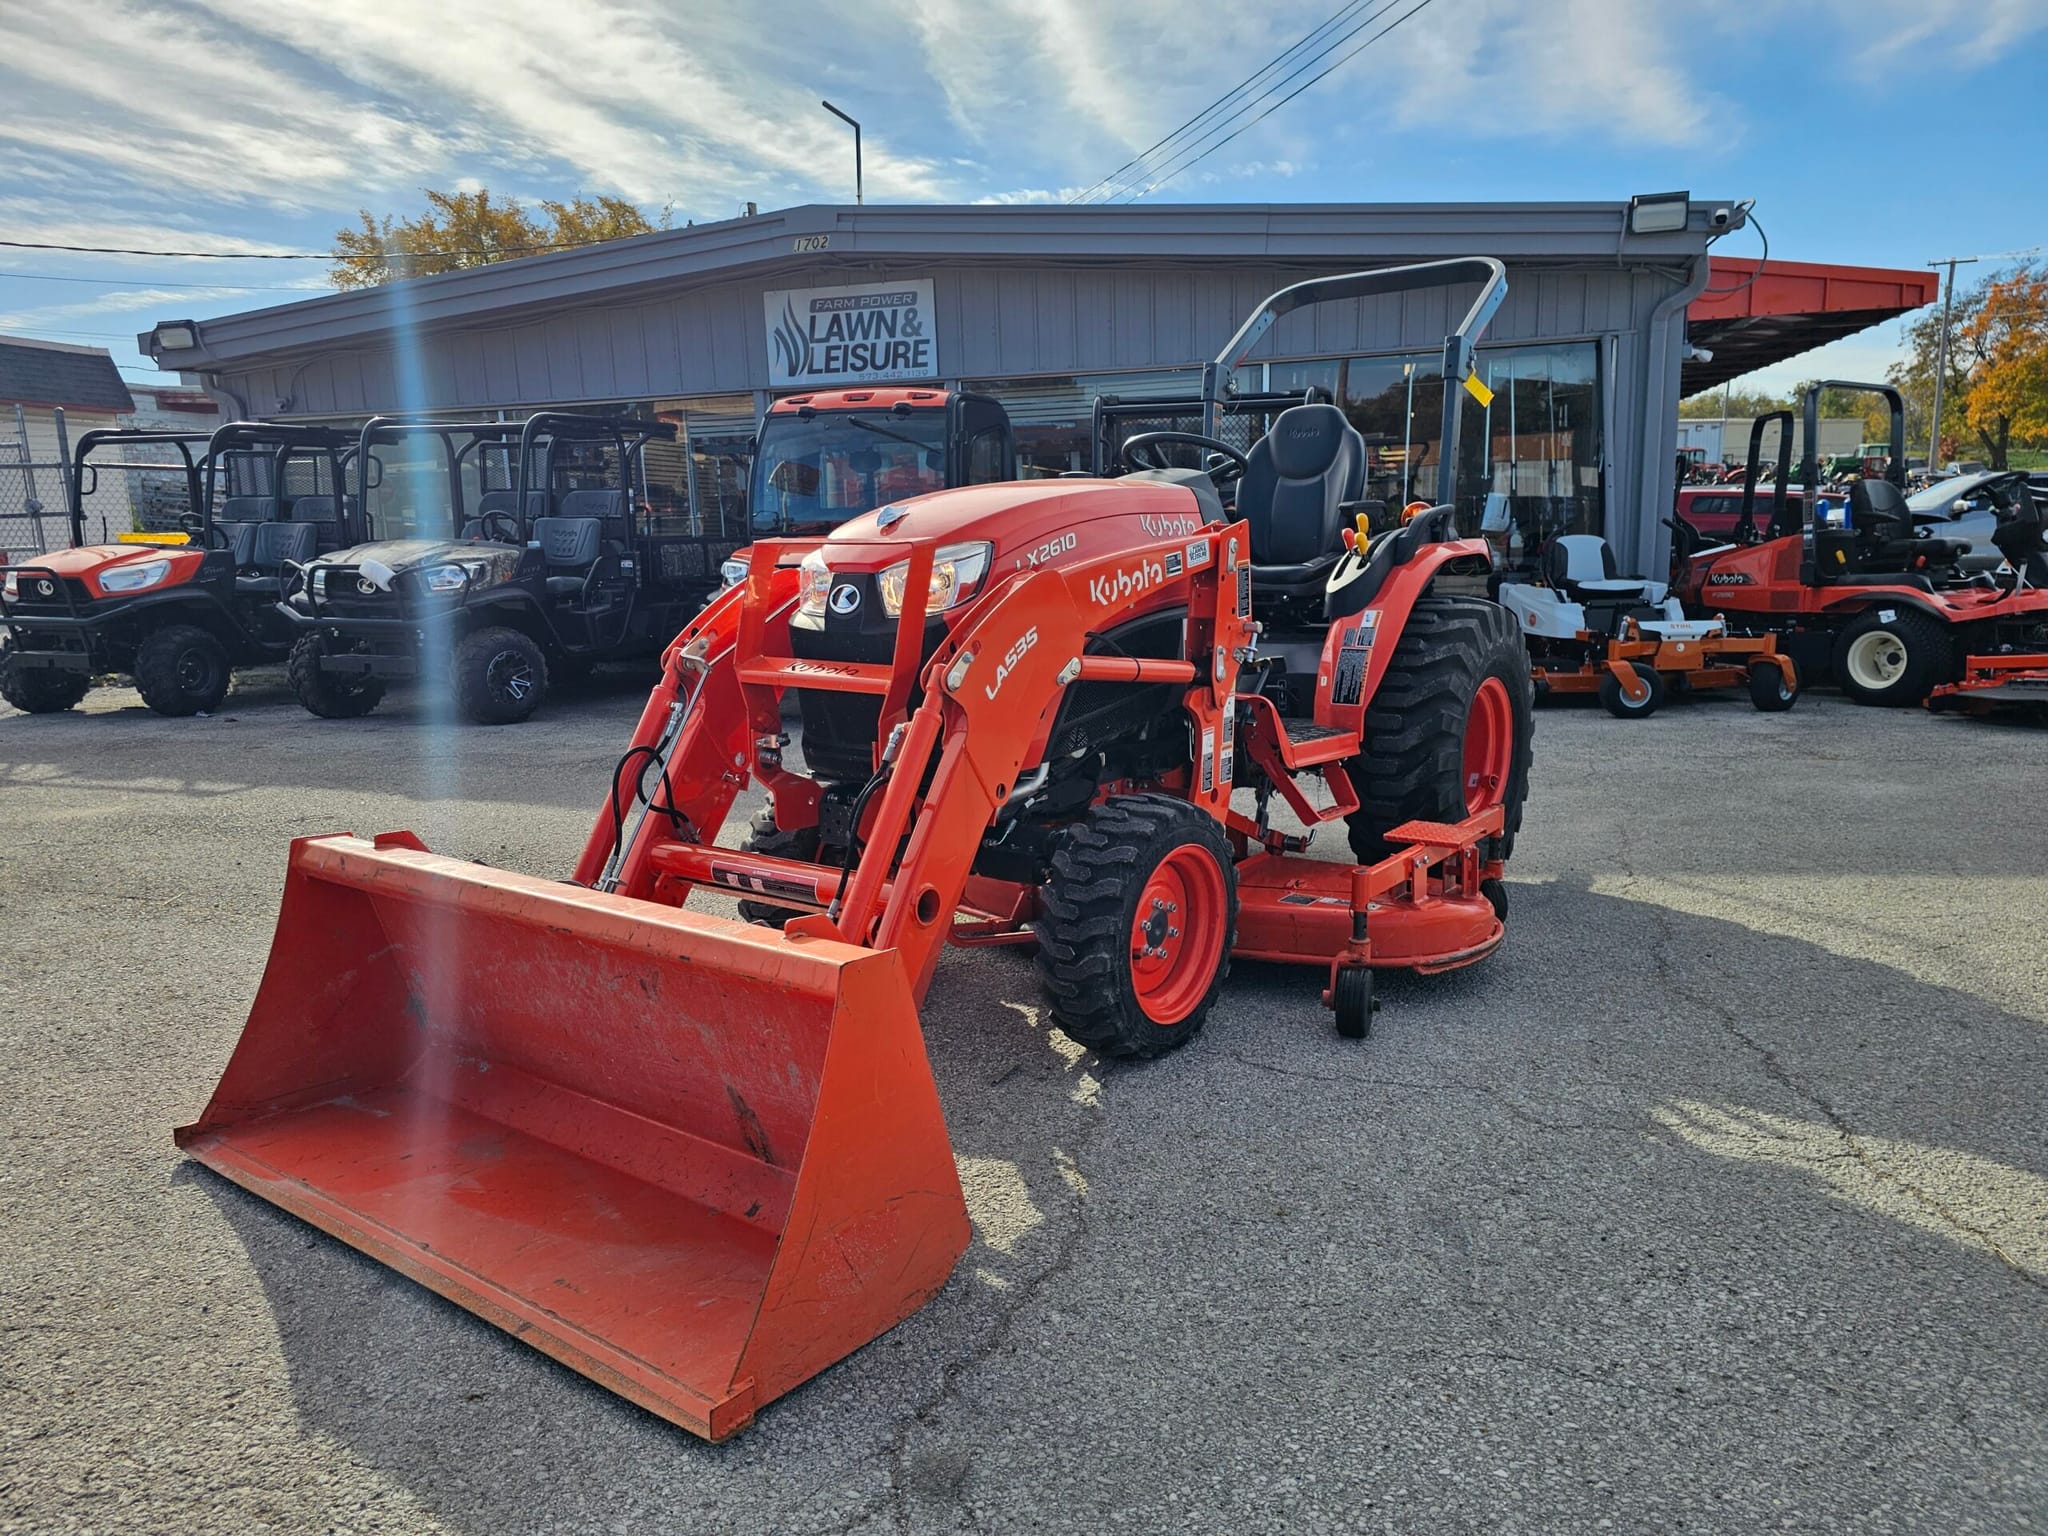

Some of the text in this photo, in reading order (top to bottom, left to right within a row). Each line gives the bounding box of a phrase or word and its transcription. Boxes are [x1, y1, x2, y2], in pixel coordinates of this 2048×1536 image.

[796, 236, 829, 250] 1702
[815, 294, 913, 310] FARM POWER
[809, 307, 922, 344] LAWN &
[807, 339, 930, 374] LEISURE
[1139, 513, 1196, 537] Kubota
[1089, 559, 1163, 606] Kubota
[1711, 574, 1743, 583] Kubota
[786, 661, 860, 676] Kubota
[985, 625, 1038, 700] LA535
